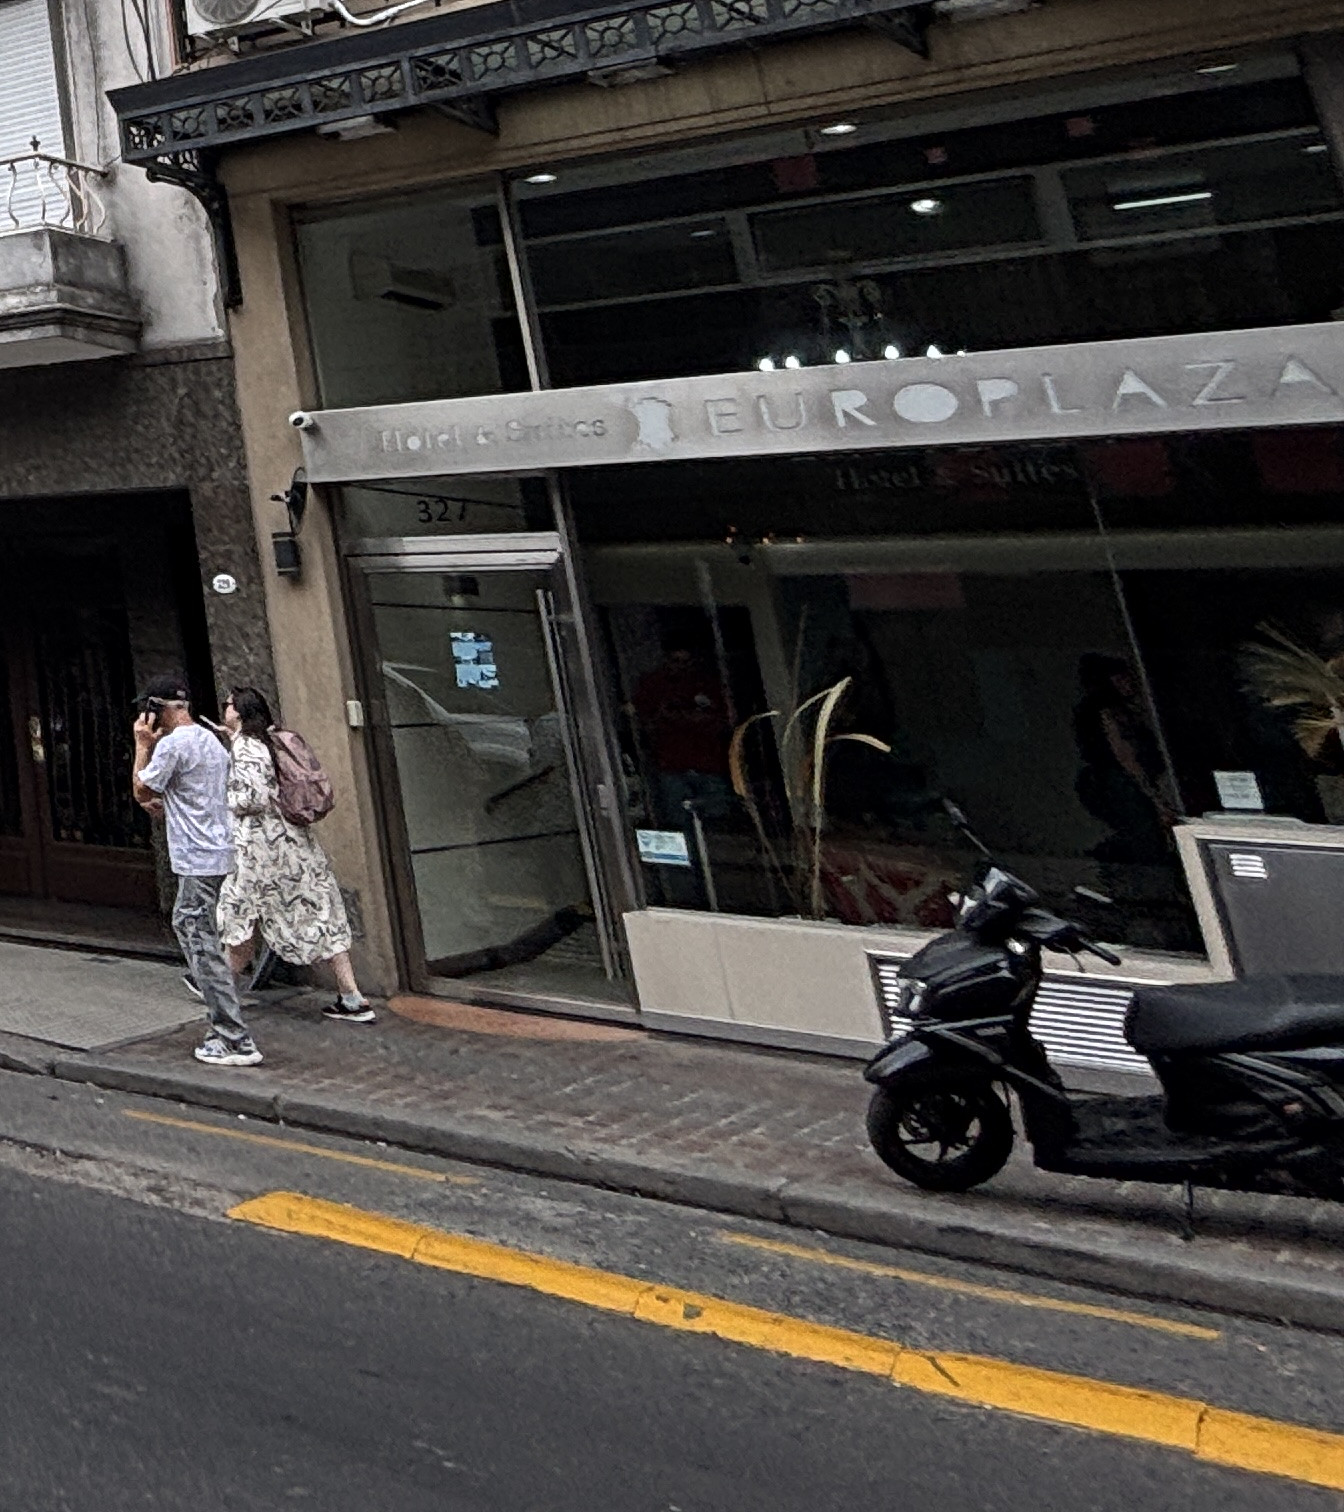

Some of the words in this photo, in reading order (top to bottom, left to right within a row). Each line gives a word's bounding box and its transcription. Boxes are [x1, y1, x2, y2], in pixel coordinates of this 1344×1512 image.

[705, 355, 1343, 436] EUROPLAZA
[380, 425, 462, 453] Hotel
[417, 498, 467, 524] 327
